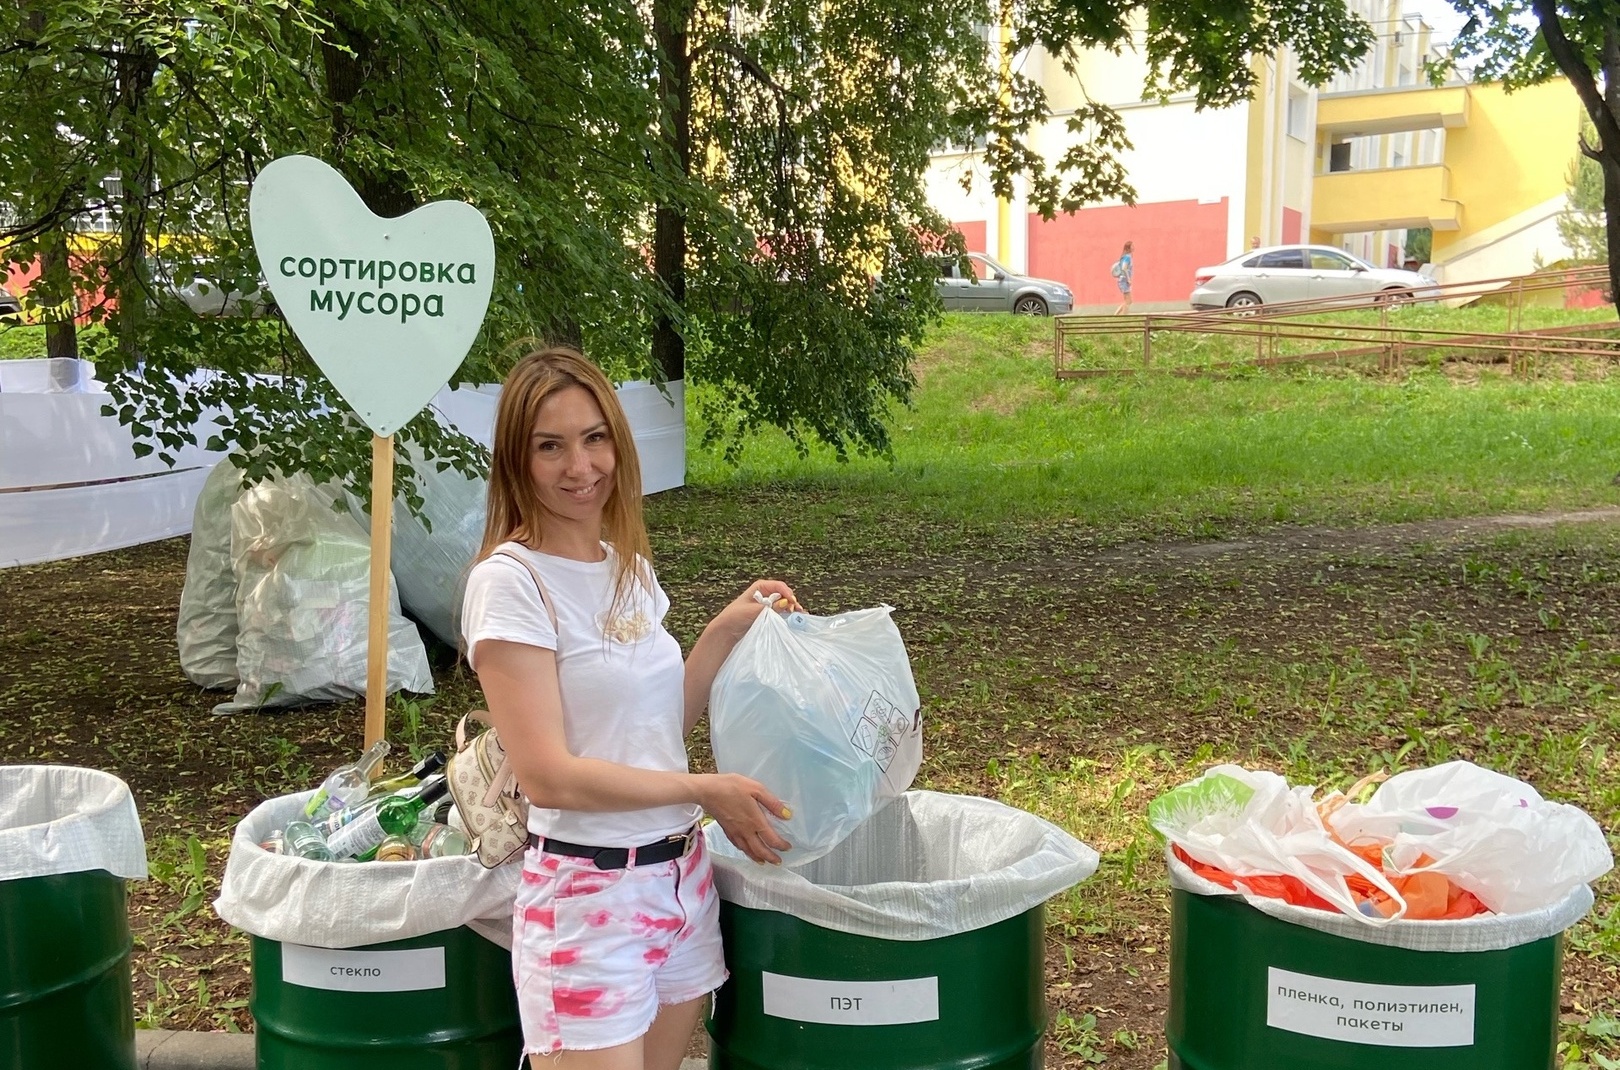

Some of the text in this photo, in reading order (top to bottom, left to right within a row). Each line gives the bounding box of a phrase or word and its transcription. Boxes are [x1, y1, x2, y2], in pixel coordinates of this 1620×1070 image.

[279, 256, 476, 289] сортировка
[310, 289, 444, 323] мусора
[330, 966, 381, 977] стекло
[830, 996, 863, 1011] ПЭТ
[1277, 985, 1464, 1015] пленка, полиэтилен,
[1336, 1015, 1404, 1032] пакеты
